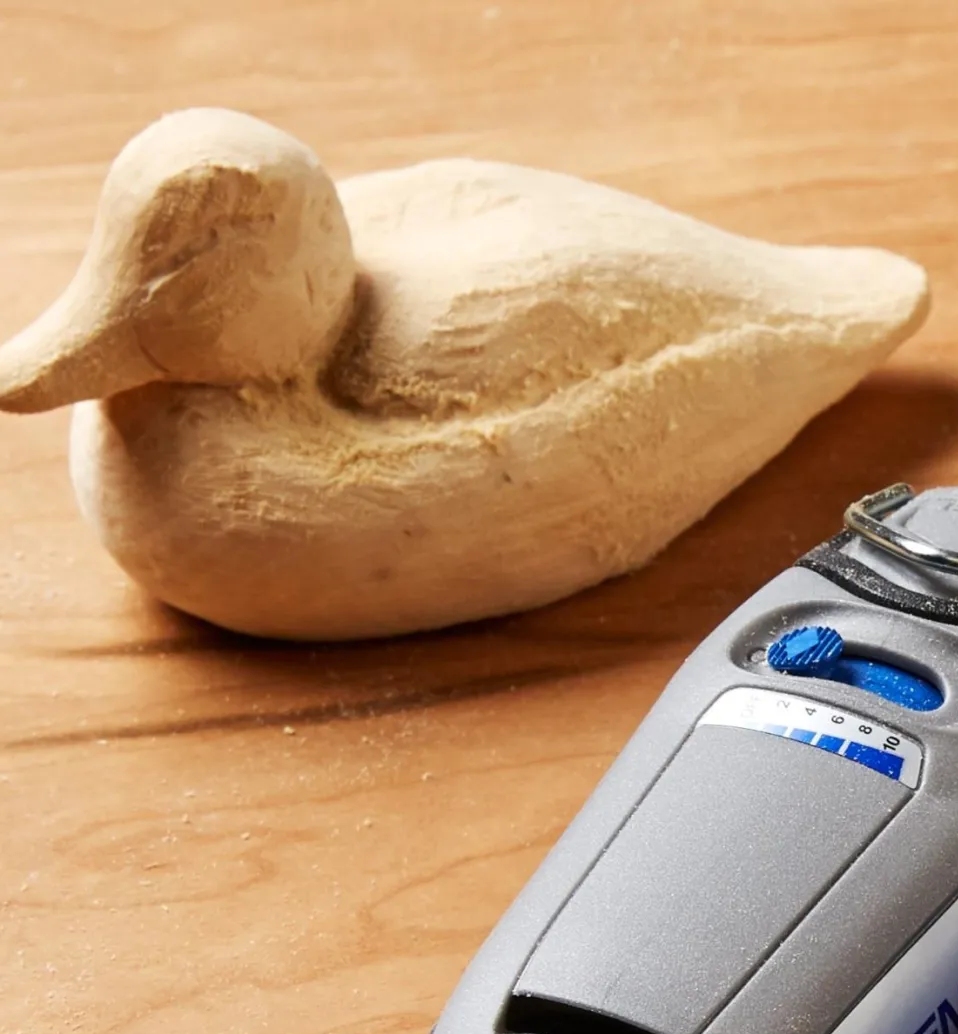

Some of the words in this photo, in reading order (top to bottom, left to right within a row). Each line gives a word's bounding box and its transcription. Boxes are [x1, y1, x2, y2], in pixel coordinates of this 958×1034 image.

[777, 699, 791, 709] 2
[805, 707, 817, 717] 4
[832, 715, 844, 725] 6
[858, 725, 873, 735] 8
[883, 736, 901, 752] 10
